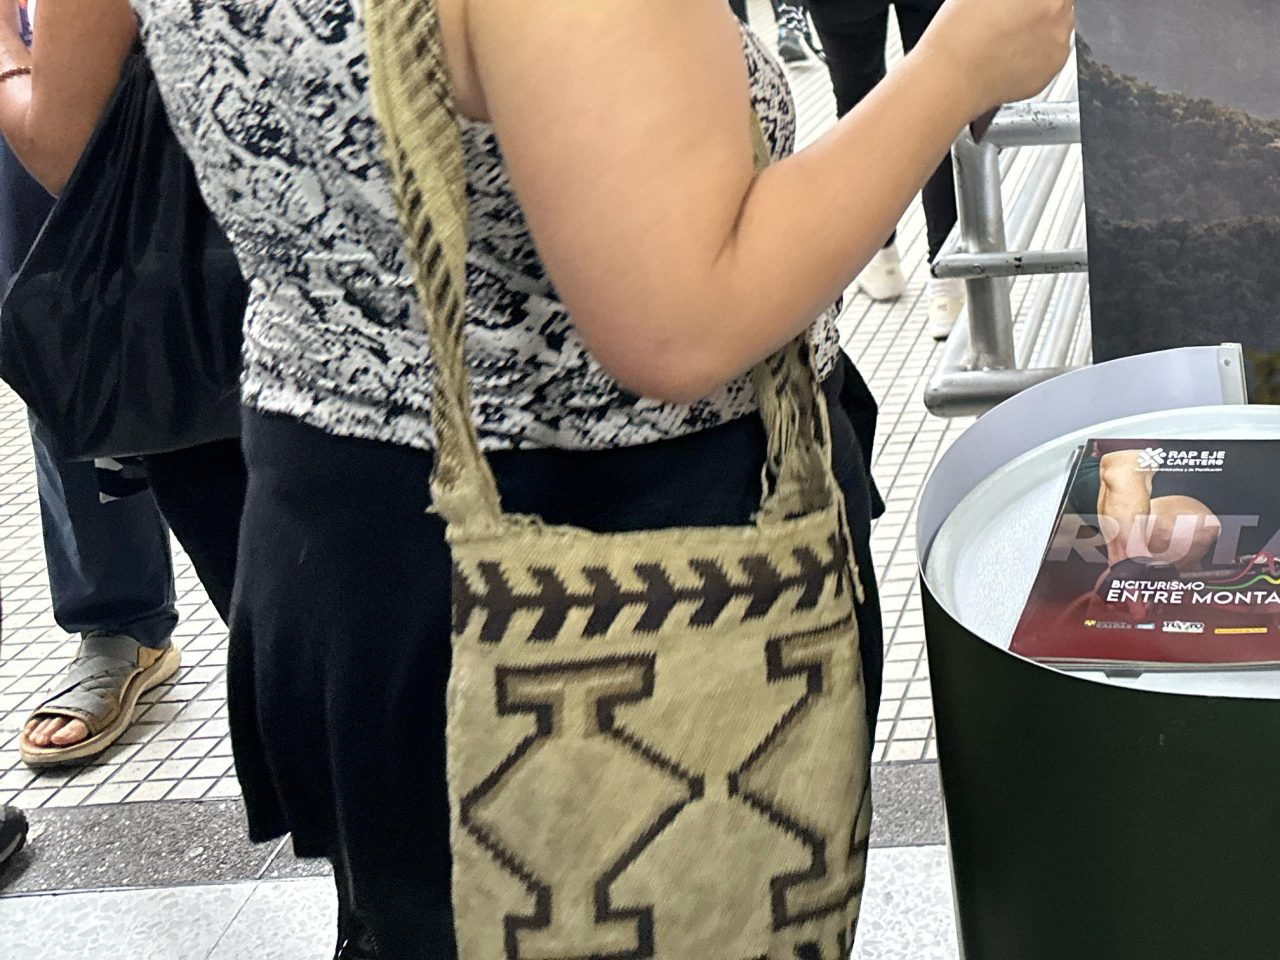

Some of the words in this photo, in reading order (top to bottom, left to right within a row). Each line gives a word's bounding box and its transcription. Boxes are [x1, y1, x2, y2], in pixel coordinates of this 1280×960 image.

[1167, 450, 1199, 459] RAP
[1200, 450, 1226, 459] EJE
[1111, 580, 1205, 591] BICITURISMO
[1106, 590, 1183, 605] ENTRE
